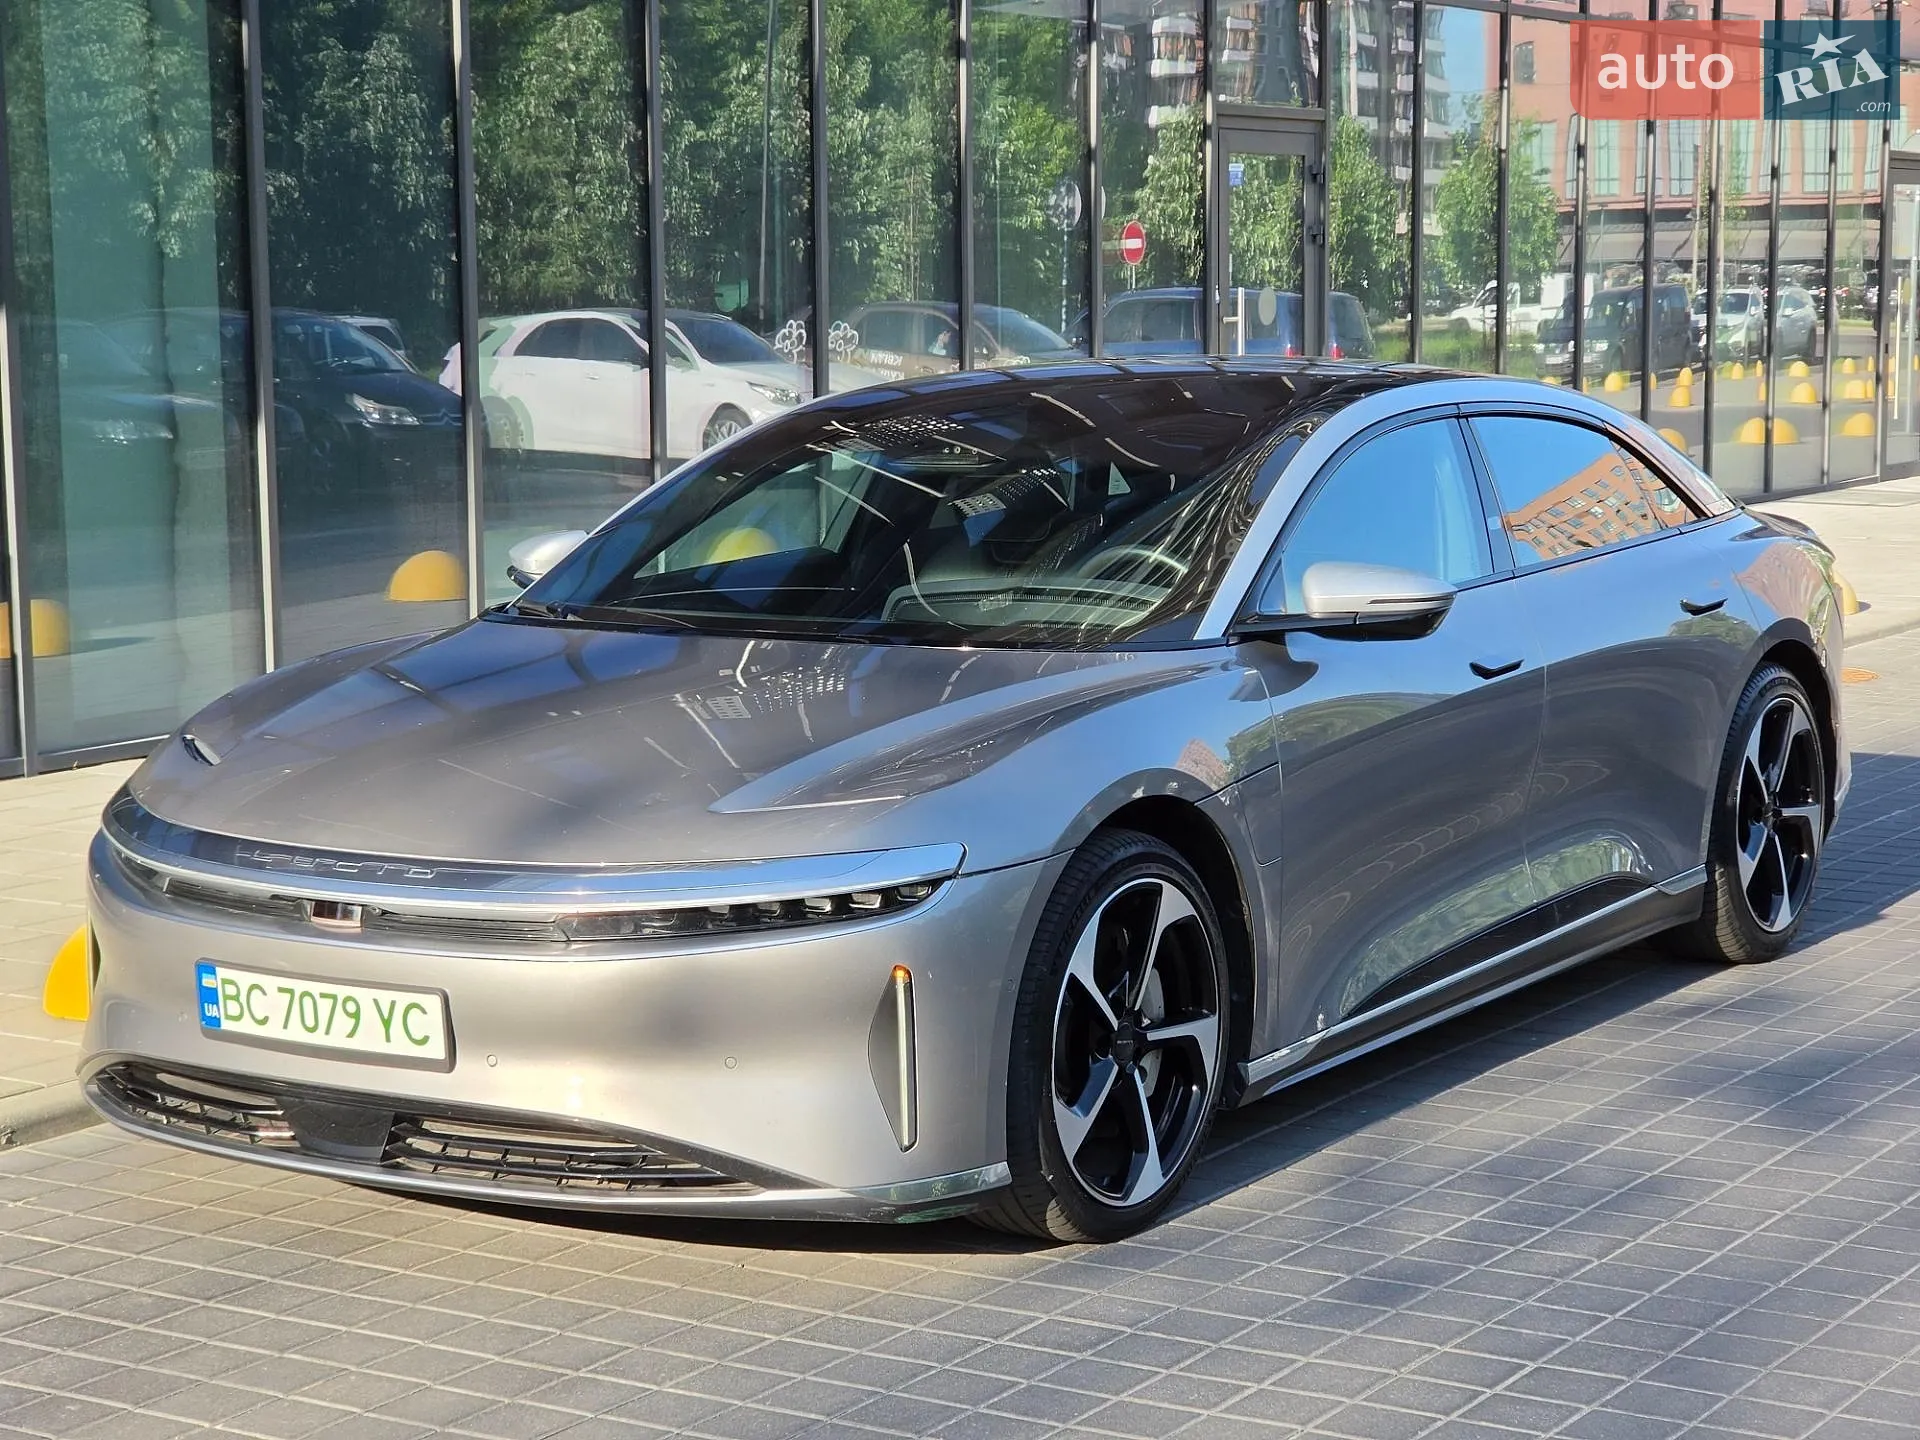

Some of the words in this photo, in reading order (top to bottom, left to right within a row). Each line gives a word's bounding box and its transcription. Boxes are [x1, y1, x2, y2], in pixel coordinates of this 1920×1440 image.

[204, 1002, 220, 1018] UA
[220, 977, 270, 1026] BC
[277, 986, 361, 1039] 7079
[372, 998, 431, 1047] YC
